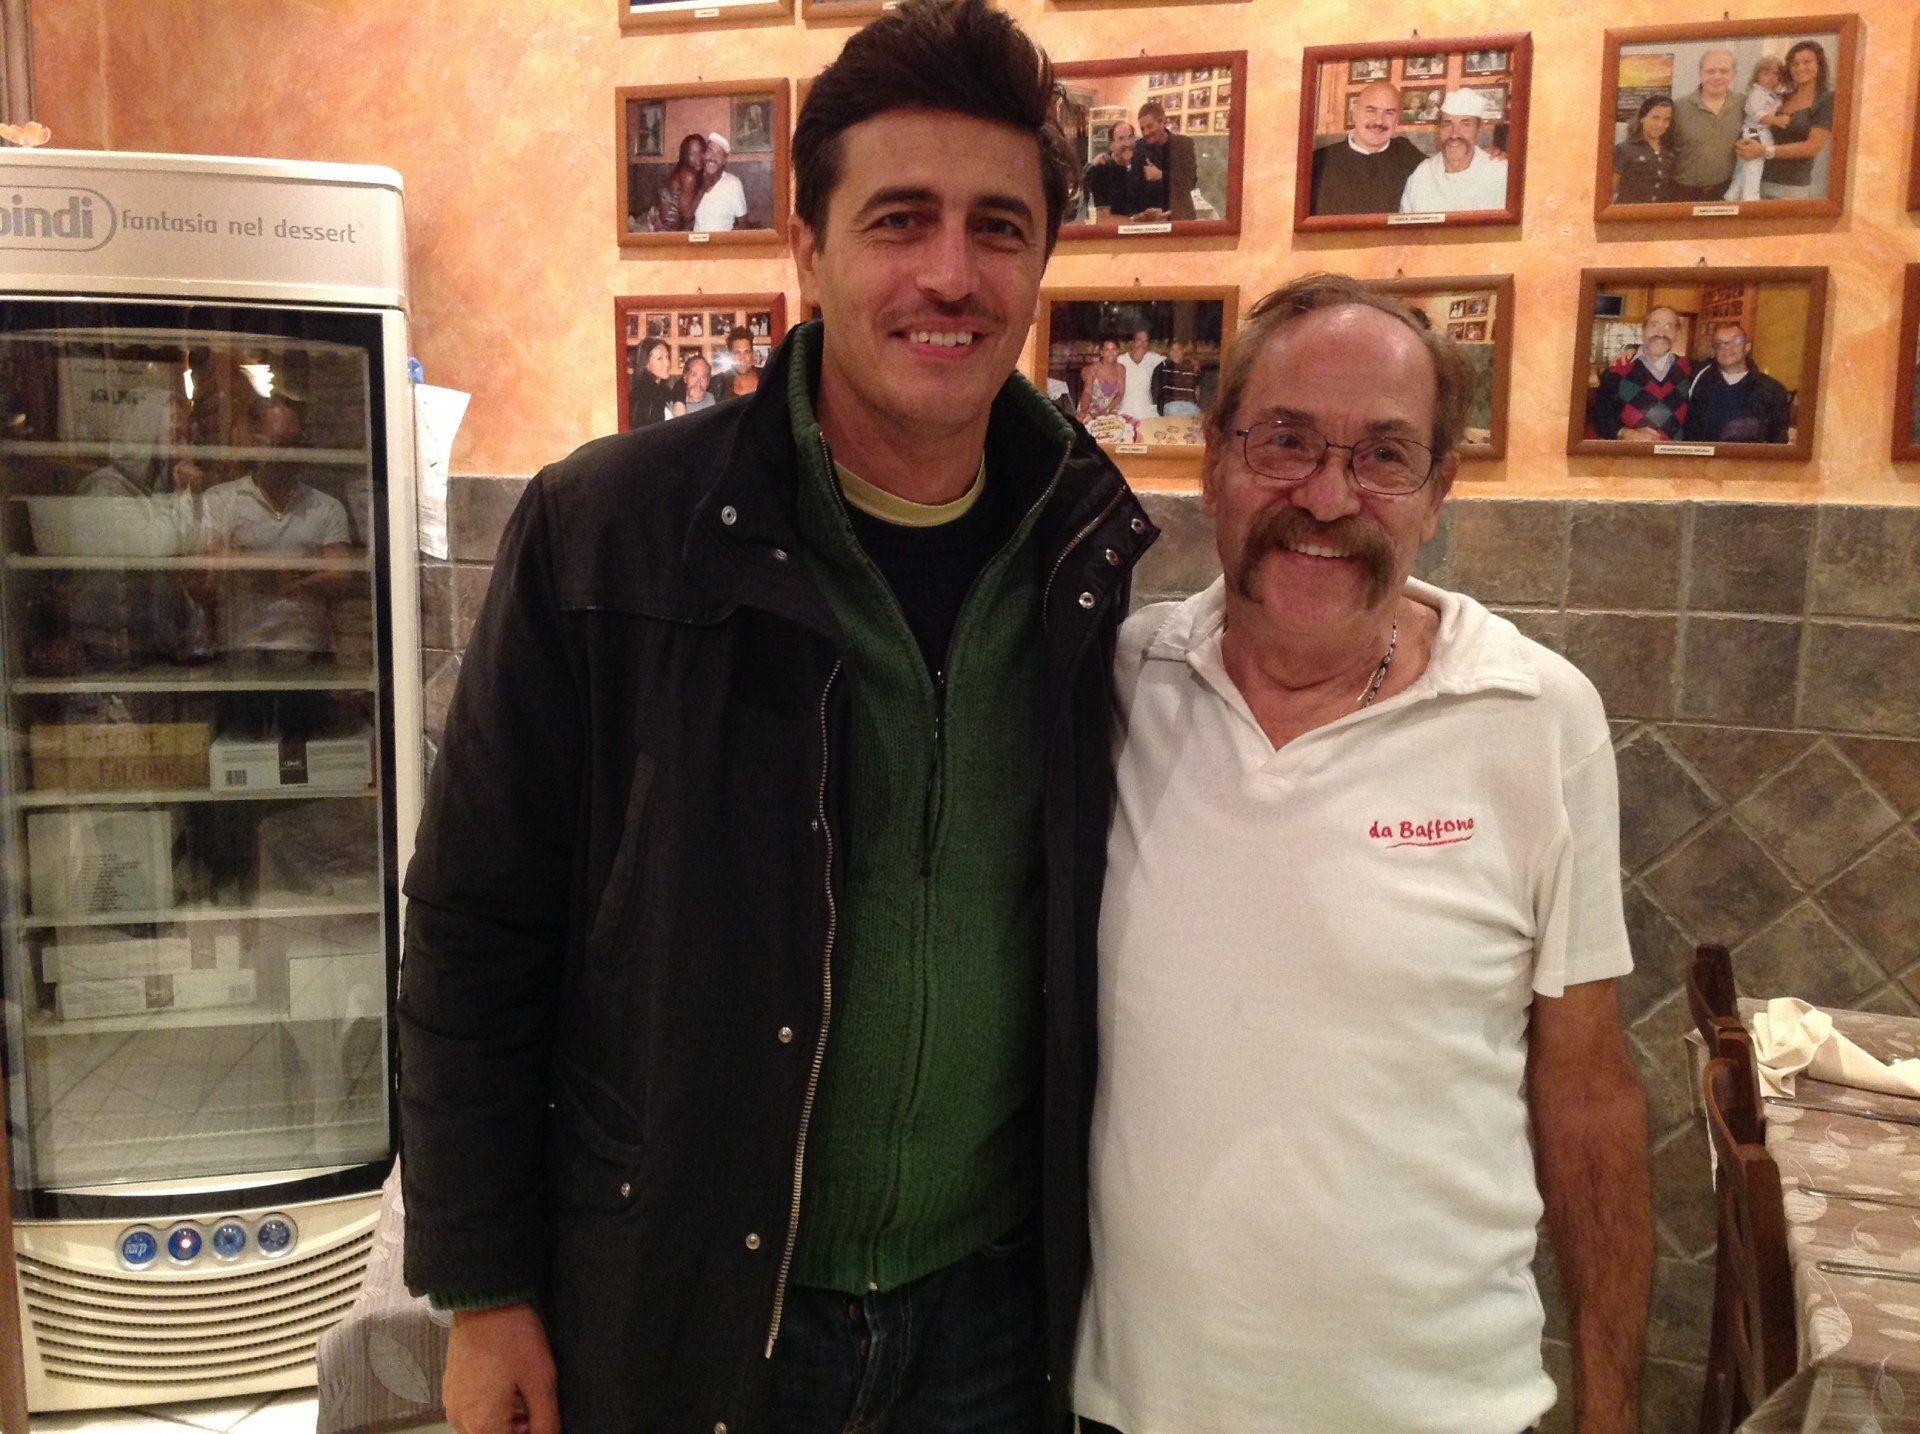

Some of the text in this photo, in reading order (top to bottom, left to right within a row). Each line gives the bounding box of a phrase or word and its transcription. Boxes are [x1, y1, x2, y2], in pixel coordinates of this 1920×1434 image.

[122, 209, 357, 244] fantasia nel dessert
[1368, 818, 1474, 840] da Baffone
